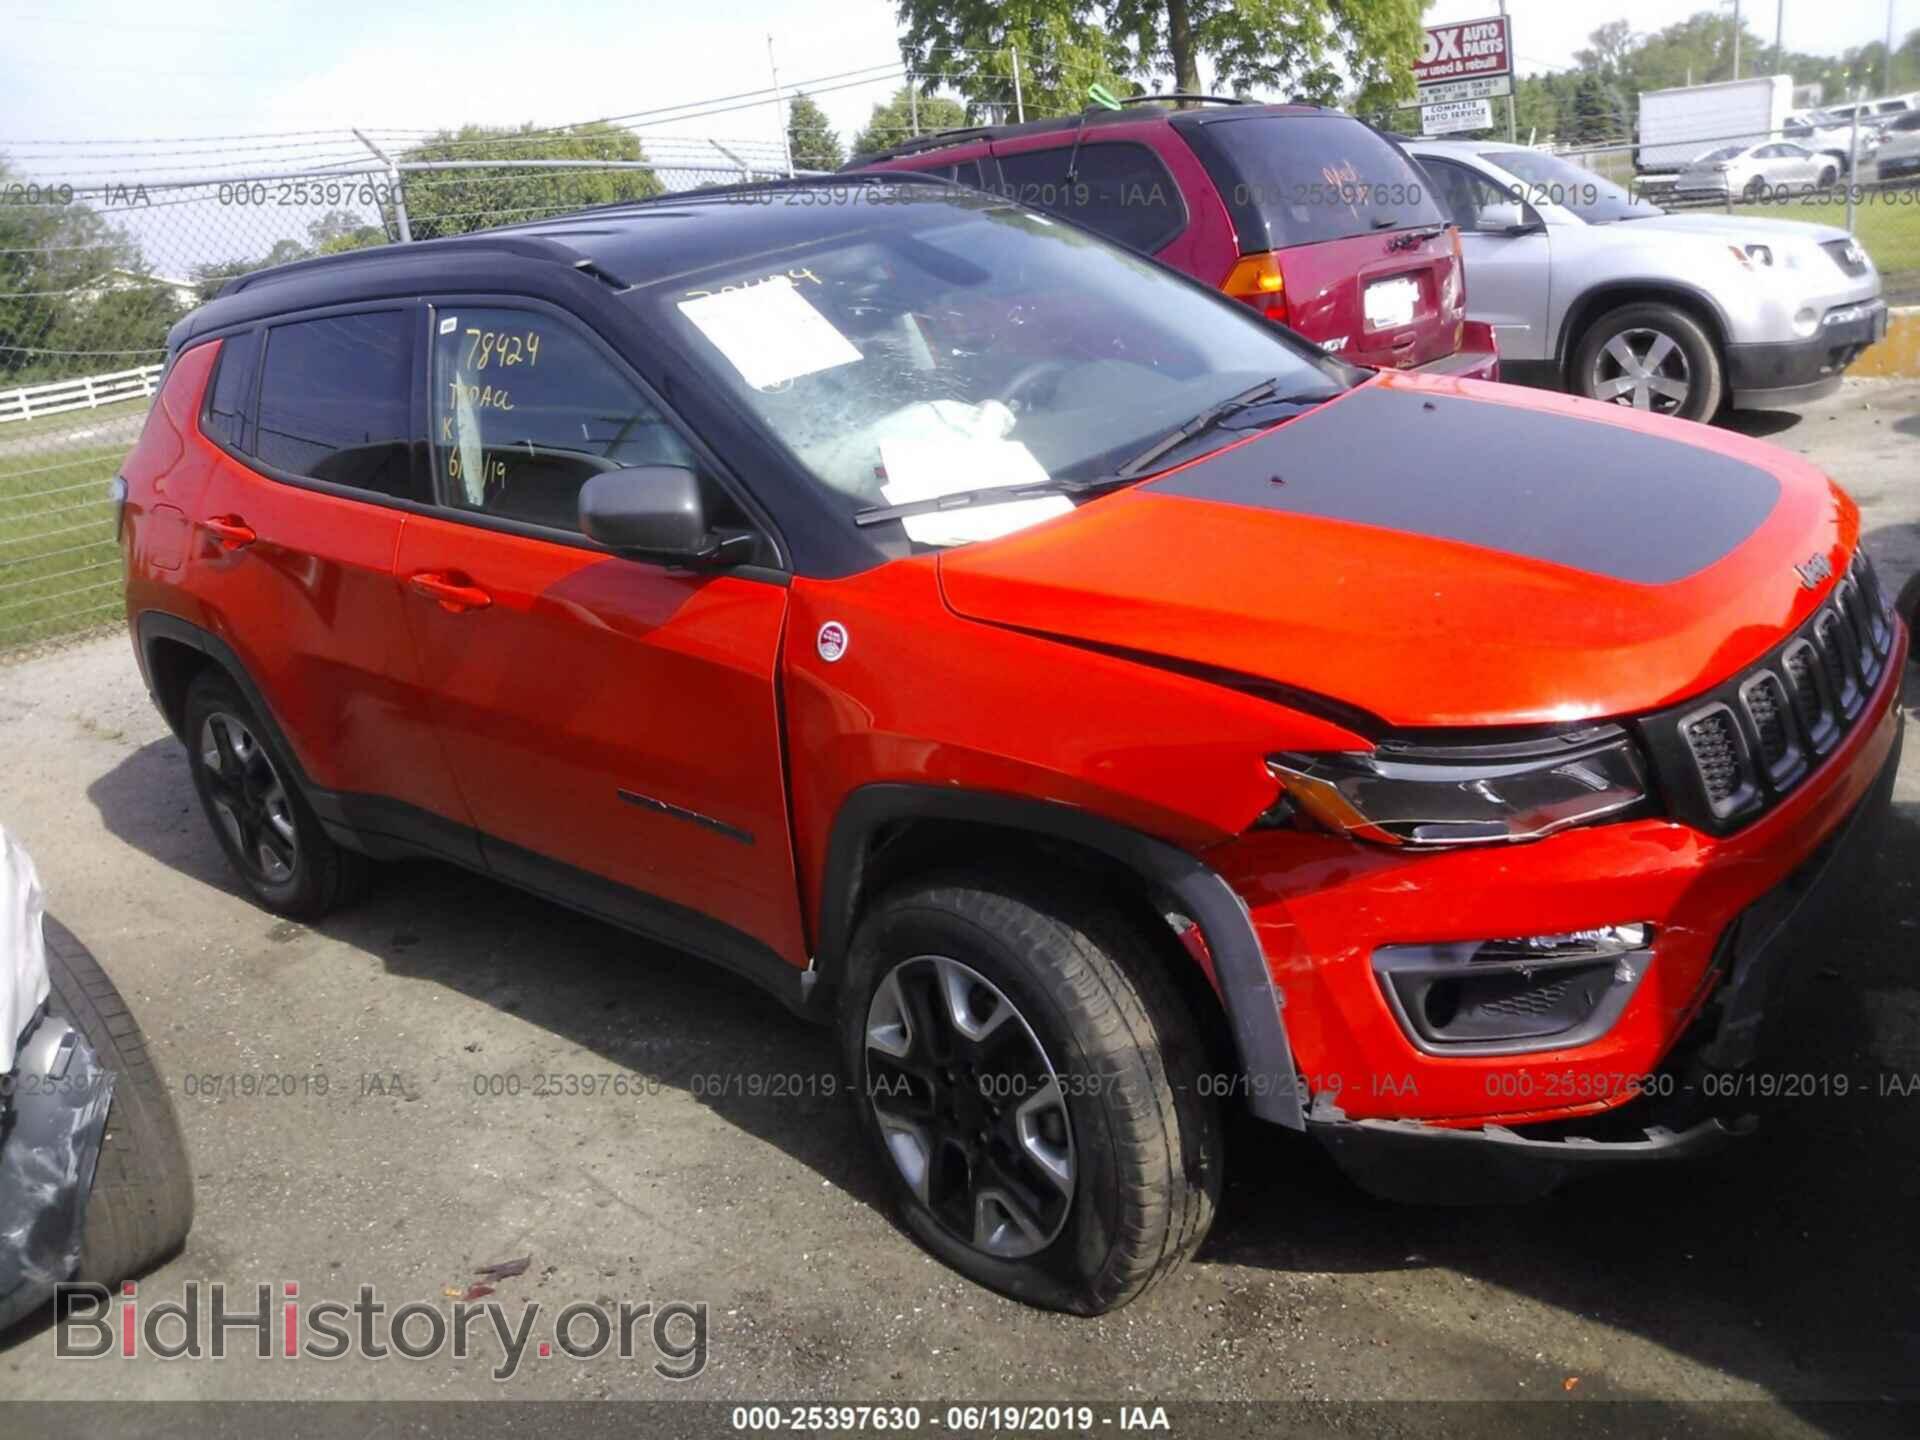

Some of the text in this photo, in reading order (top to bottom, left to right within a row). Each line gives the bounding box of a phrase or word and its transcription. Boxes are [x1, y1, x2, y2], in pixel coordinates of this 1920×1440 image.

[1462, 23, 1499, 42] AUTO
[1417, 28, 1462, 64] OX
[1463, 38, 1504, 57] PARTS
[1455, 60, 1464, 73] &
[1424, 107, 1487, 122] AUTO SERVICE
[1430, 102, 1477, 114] COMPLETE
[464, 328, 541, 371] 78424
[448, 441, 507, 490] 6//19
